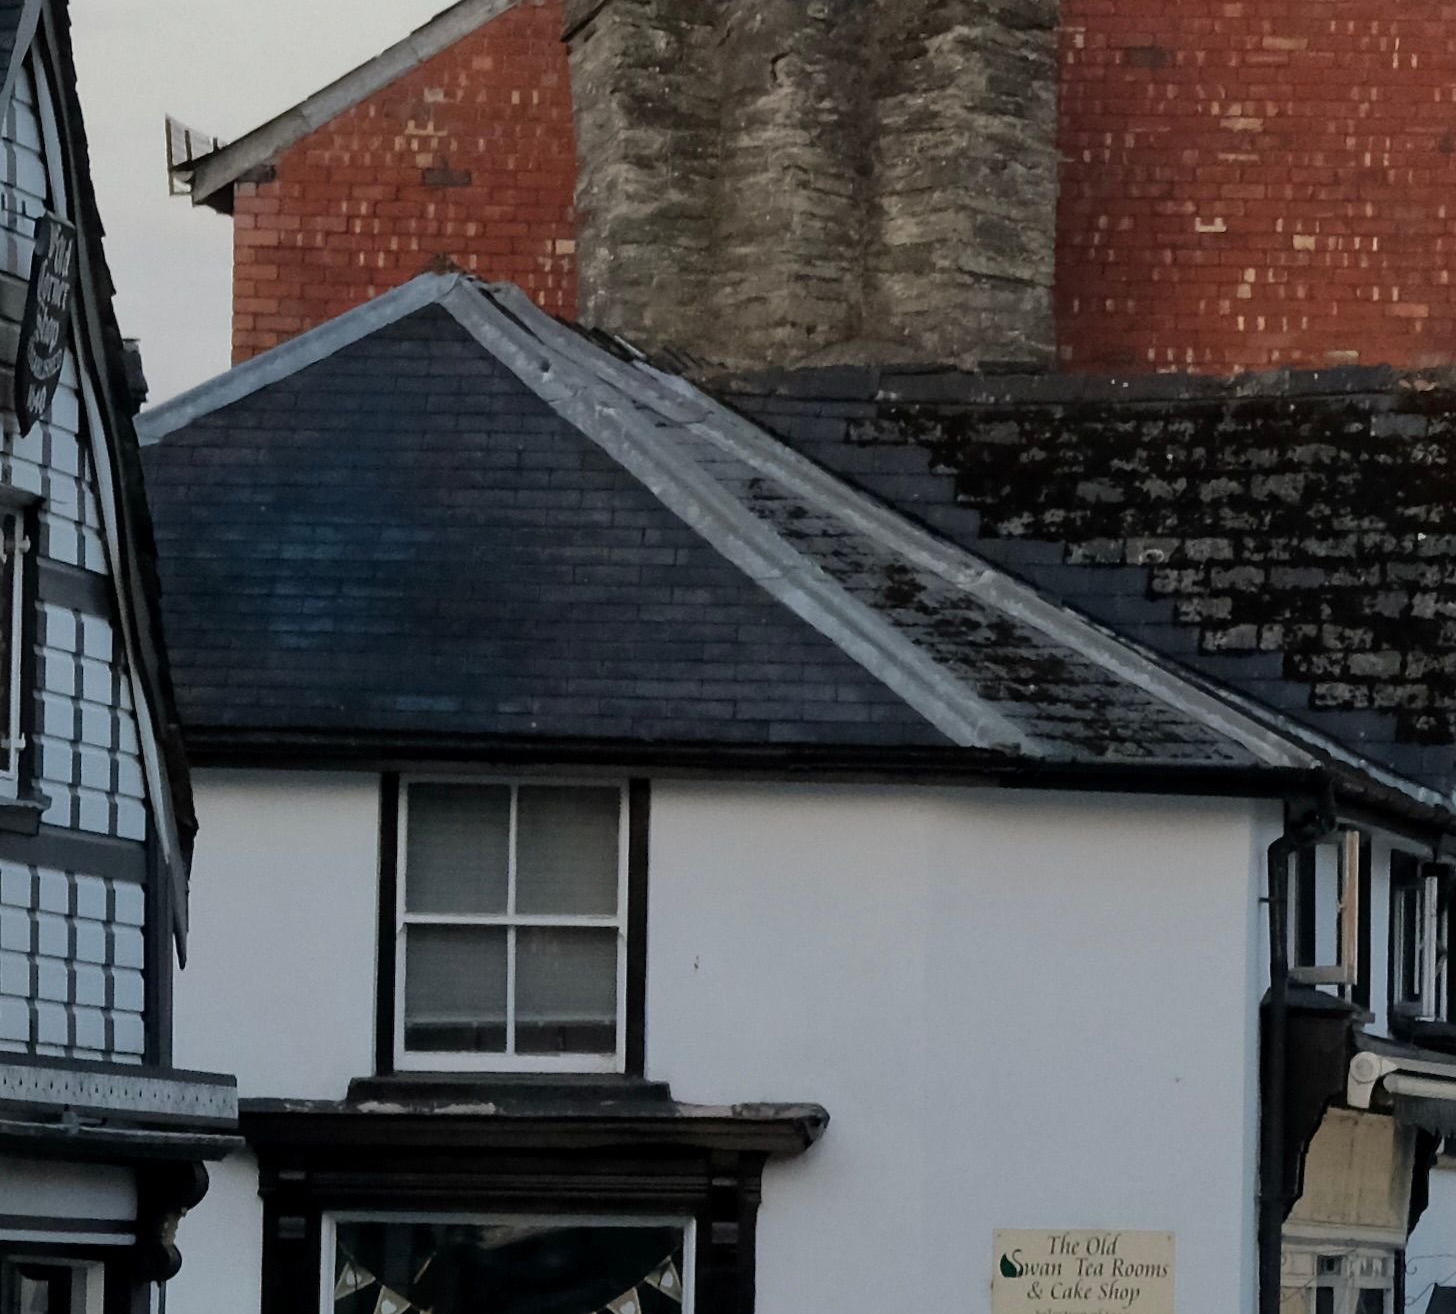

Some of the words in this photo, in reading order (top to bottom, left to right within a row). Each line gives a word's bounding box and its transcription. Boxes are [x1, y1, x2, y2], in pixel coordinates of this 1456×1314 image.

[1048, 1233, 1080, 1256] The
[1086, 1233, 1122, 1256] Old
[1009, 1249, 1062, 1278] Swan
[1075, 1257, 1104, 1277] Tea
[1112, 1257, 1169, 1278] Rooms
[1027, 1281, 1043, 1300] &
[1050, 1279, 1093, 1300] Cake
[1098, 1279, 1141, 1309] Shop
